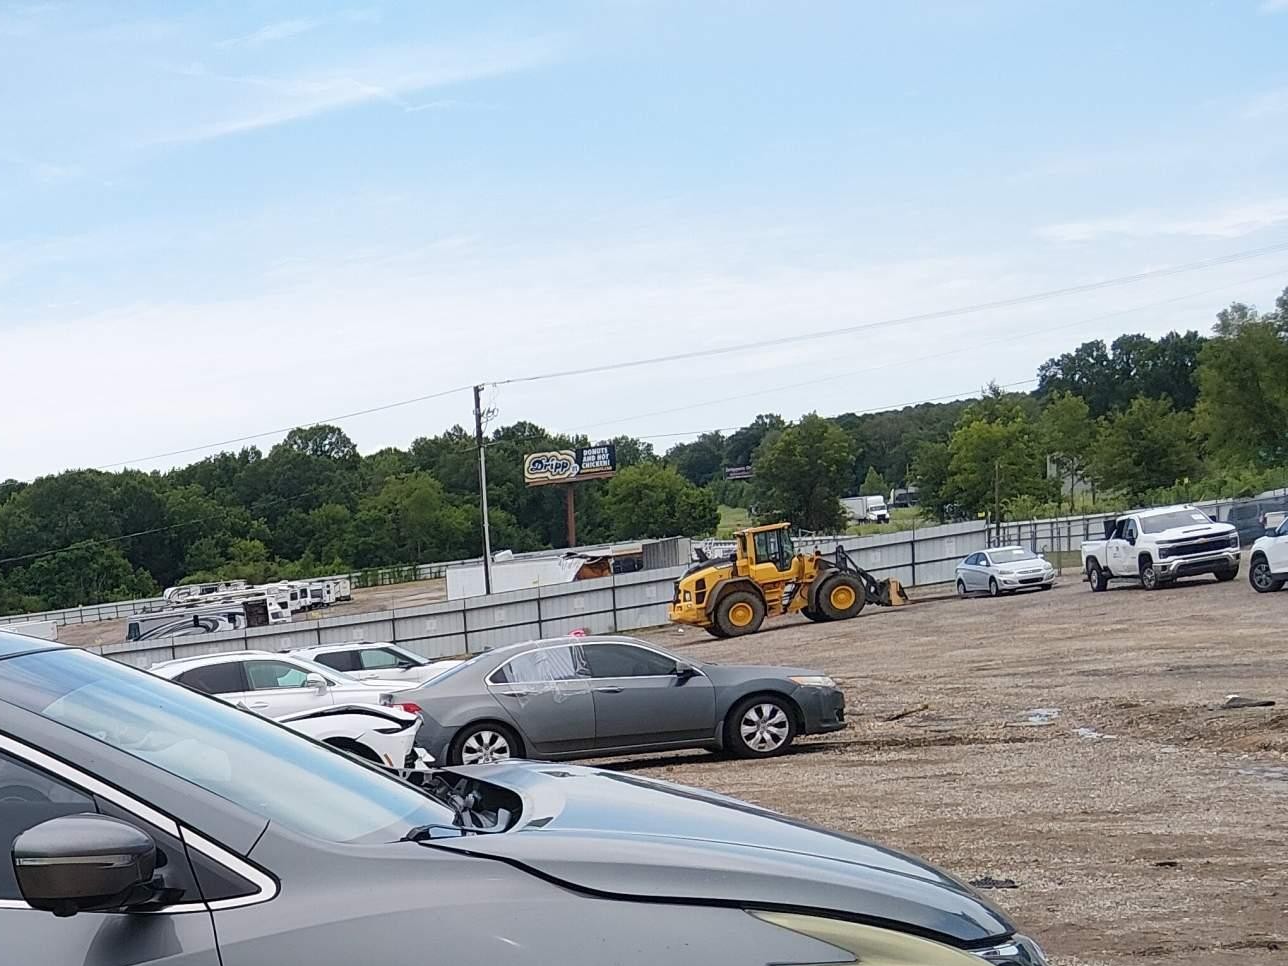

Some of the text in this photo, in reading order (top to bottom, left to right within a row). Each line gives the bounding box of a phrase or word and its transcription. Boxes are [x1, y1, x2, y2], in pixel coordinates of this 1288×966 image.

[583, 447, 608, 456] DONUTS
[597, 453, 610, 461] HOT
[531, 457, 570, 473] Dripp
[582, 459, 611, 469] CHICKEN!
